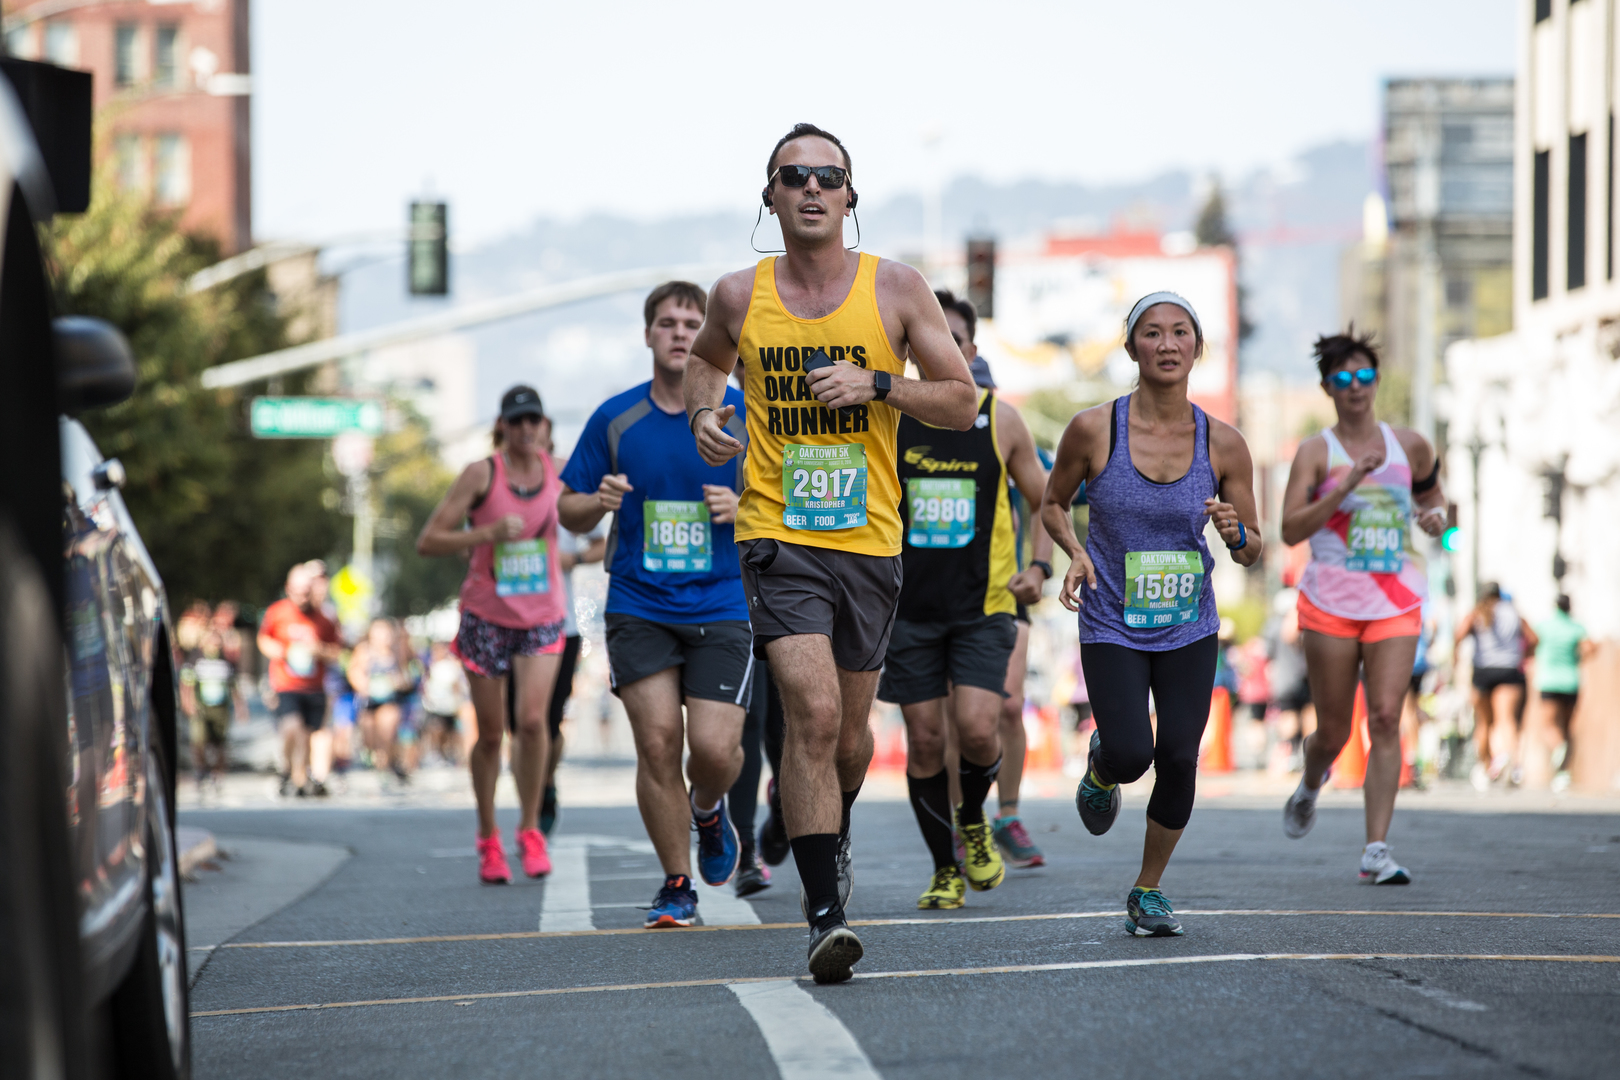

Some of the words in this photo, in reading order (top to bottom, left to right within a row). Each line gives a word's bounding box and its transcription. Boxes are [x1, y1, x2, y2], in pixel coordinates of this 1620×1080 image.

[759, 346, 866, 371] WORD'S
[768, 405, 869, 436] RUNNER
[799, 447, 837, 459] OAKTOWN
[839, 447, 849, 457] 5K
[793, 468, 858, 498] 2917
[805, 500, 845, 508] KRISTOPHER
[913, 498, 970, 522] 2980
[786, 514, 807, 526] BEER
[815, 515, 835, 526] FOOD
[650, 520, 704, 546] 1866
[1351, 526, 1399, 550] 2950
[1140, 554, 1176, 564] OAKTOWN
[1177, 554, 1187, 563] 5K
[1134, 573, 1195, 599] 1588
[1149, 600, 1178, 609] MICHELLE
[1128, 614, 1147, 624] BEER
[1154, 614, 1172, 624] FOOD
